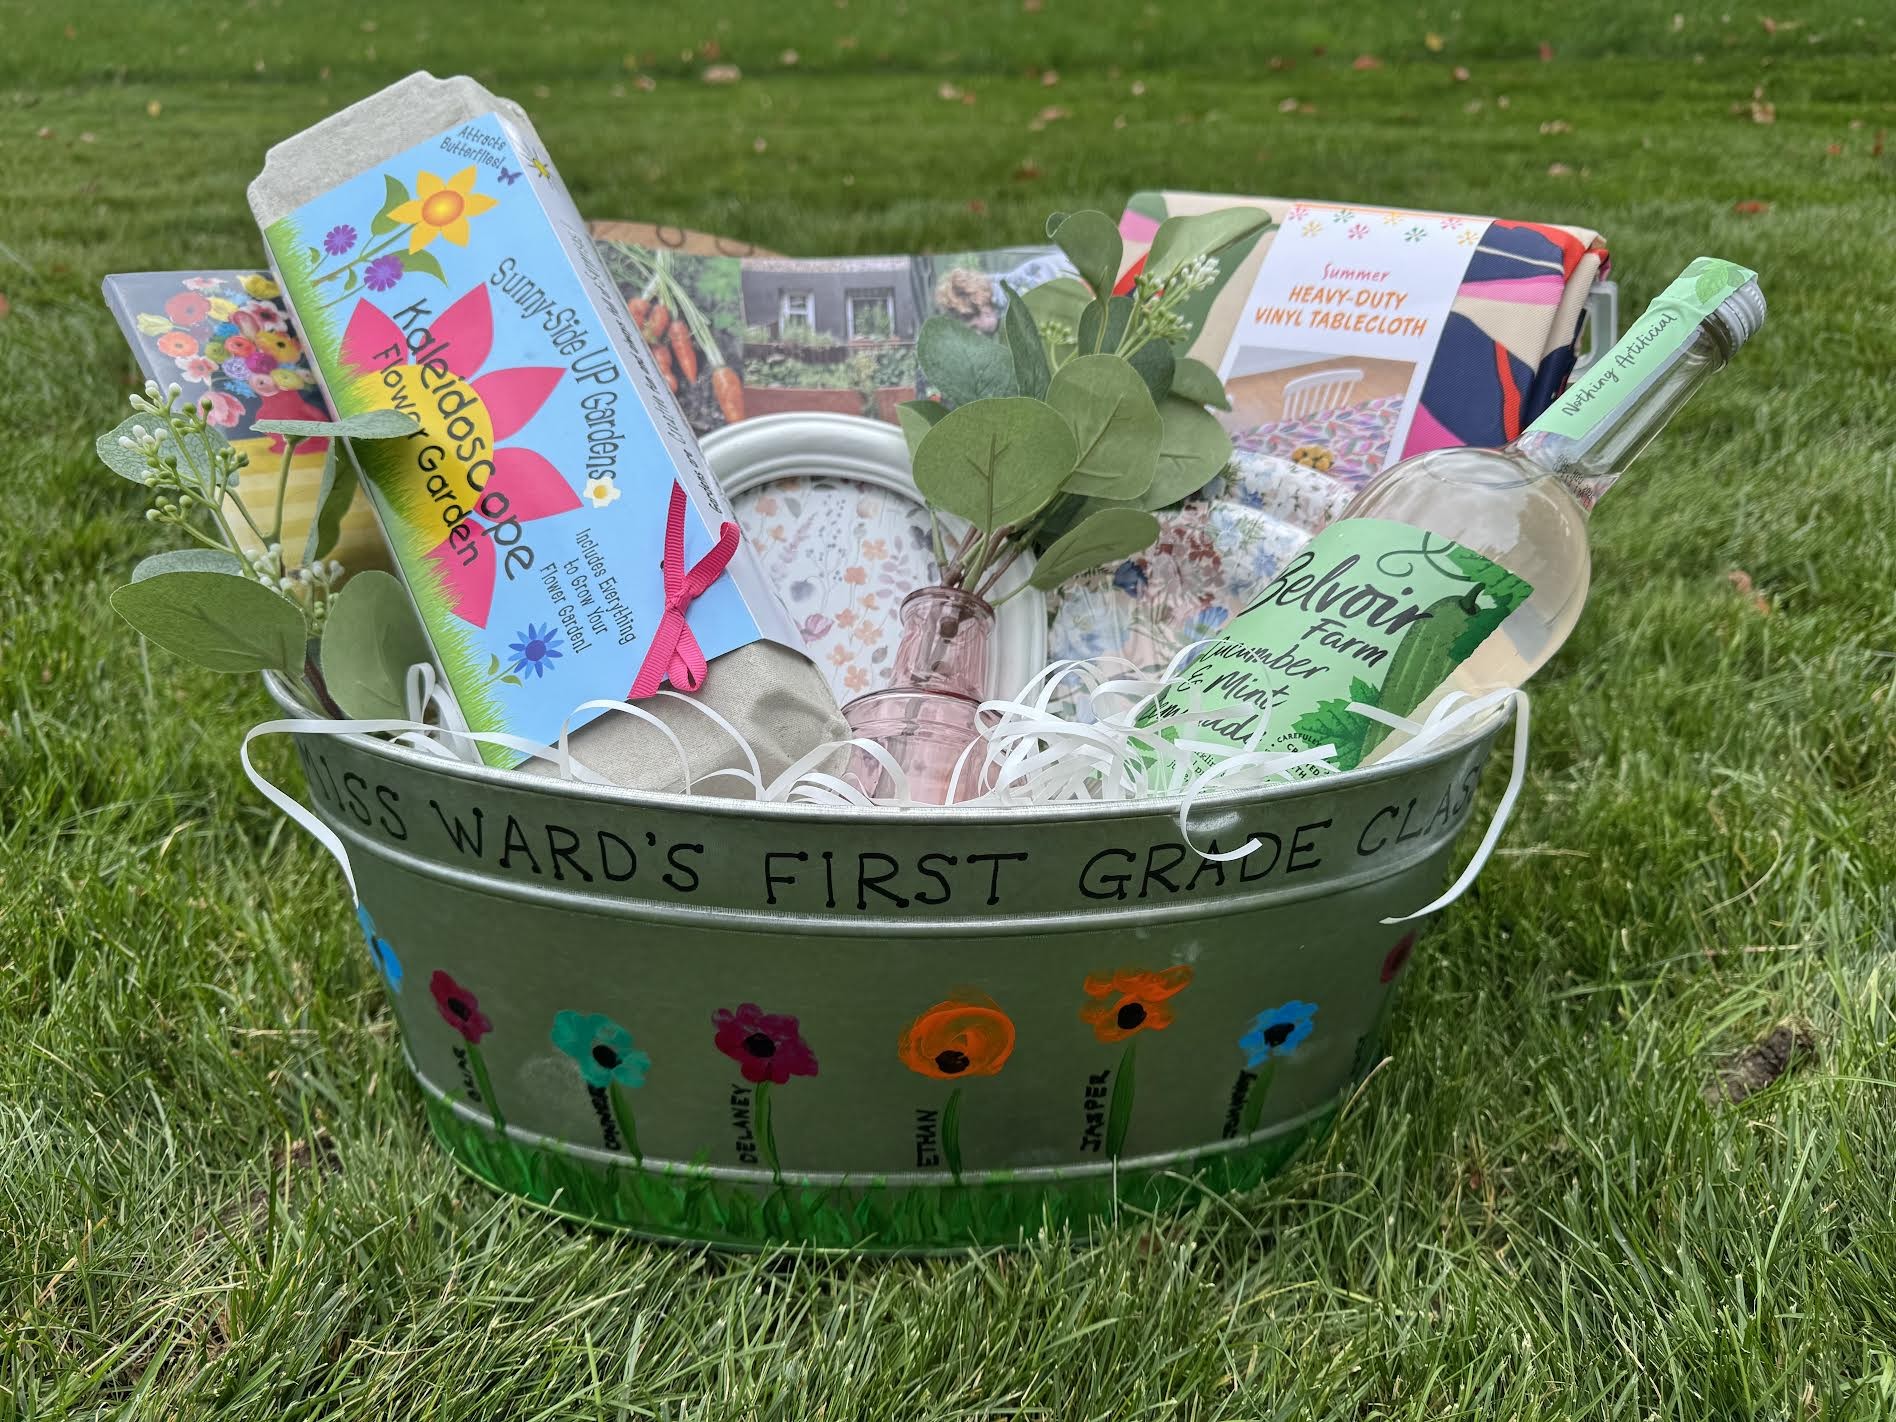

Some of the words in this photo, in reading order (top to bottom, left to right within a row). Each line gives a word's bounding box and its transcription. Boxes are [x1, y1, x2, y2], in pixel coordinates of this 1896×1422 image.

[440, 136, 506, 169] Butterflies!
[457, 125, 506, 151] Attracts
[490, 256, 588, 357] Sunny-Side
[1288, 285, 1408, 310] HEAVY-DUTY
[1322, 262, 1390, 282] Summer
[1255, 306, 1304, 327] VINYL
[1308, 310, 1427, 337] TABLECLOTH
[571, 346, 620, 385] UP
[1562, 367, 1620, 416] Nothing
[1615, 313, 1677, 368] Artificial
[393, 298, 535, 581] Kaleidoscope
[581, 390, 625, 480] Gardens
[417, 444, 479, 567] Garden
[540, 562, 566, 604] Flower
[558, 604, 592, 654] Garden!
[563, 557, 579, 575] to
[571, 575, 595, 606] Grow
[587, 606, 608, 635] Your
[575, 527, 607, 577] Includes
[598, 576, 637, 645] Everything
[1237, 551, 1434, 635] Belvoir
[1300, 618, 1388, 668] Farm
[429, 800, 704, 892] WARD'S
[762, 851, 1029, 909] FIRST
[1079, 818, 1332, 901] GRADE
[1356, 766, 1480, 856] CLAS
[731, 1083, 758, 1164] DELANEY
[915, 1107, 940, 1169] ETHAN
[1079, 1069, 1111, 1153] JASPER
